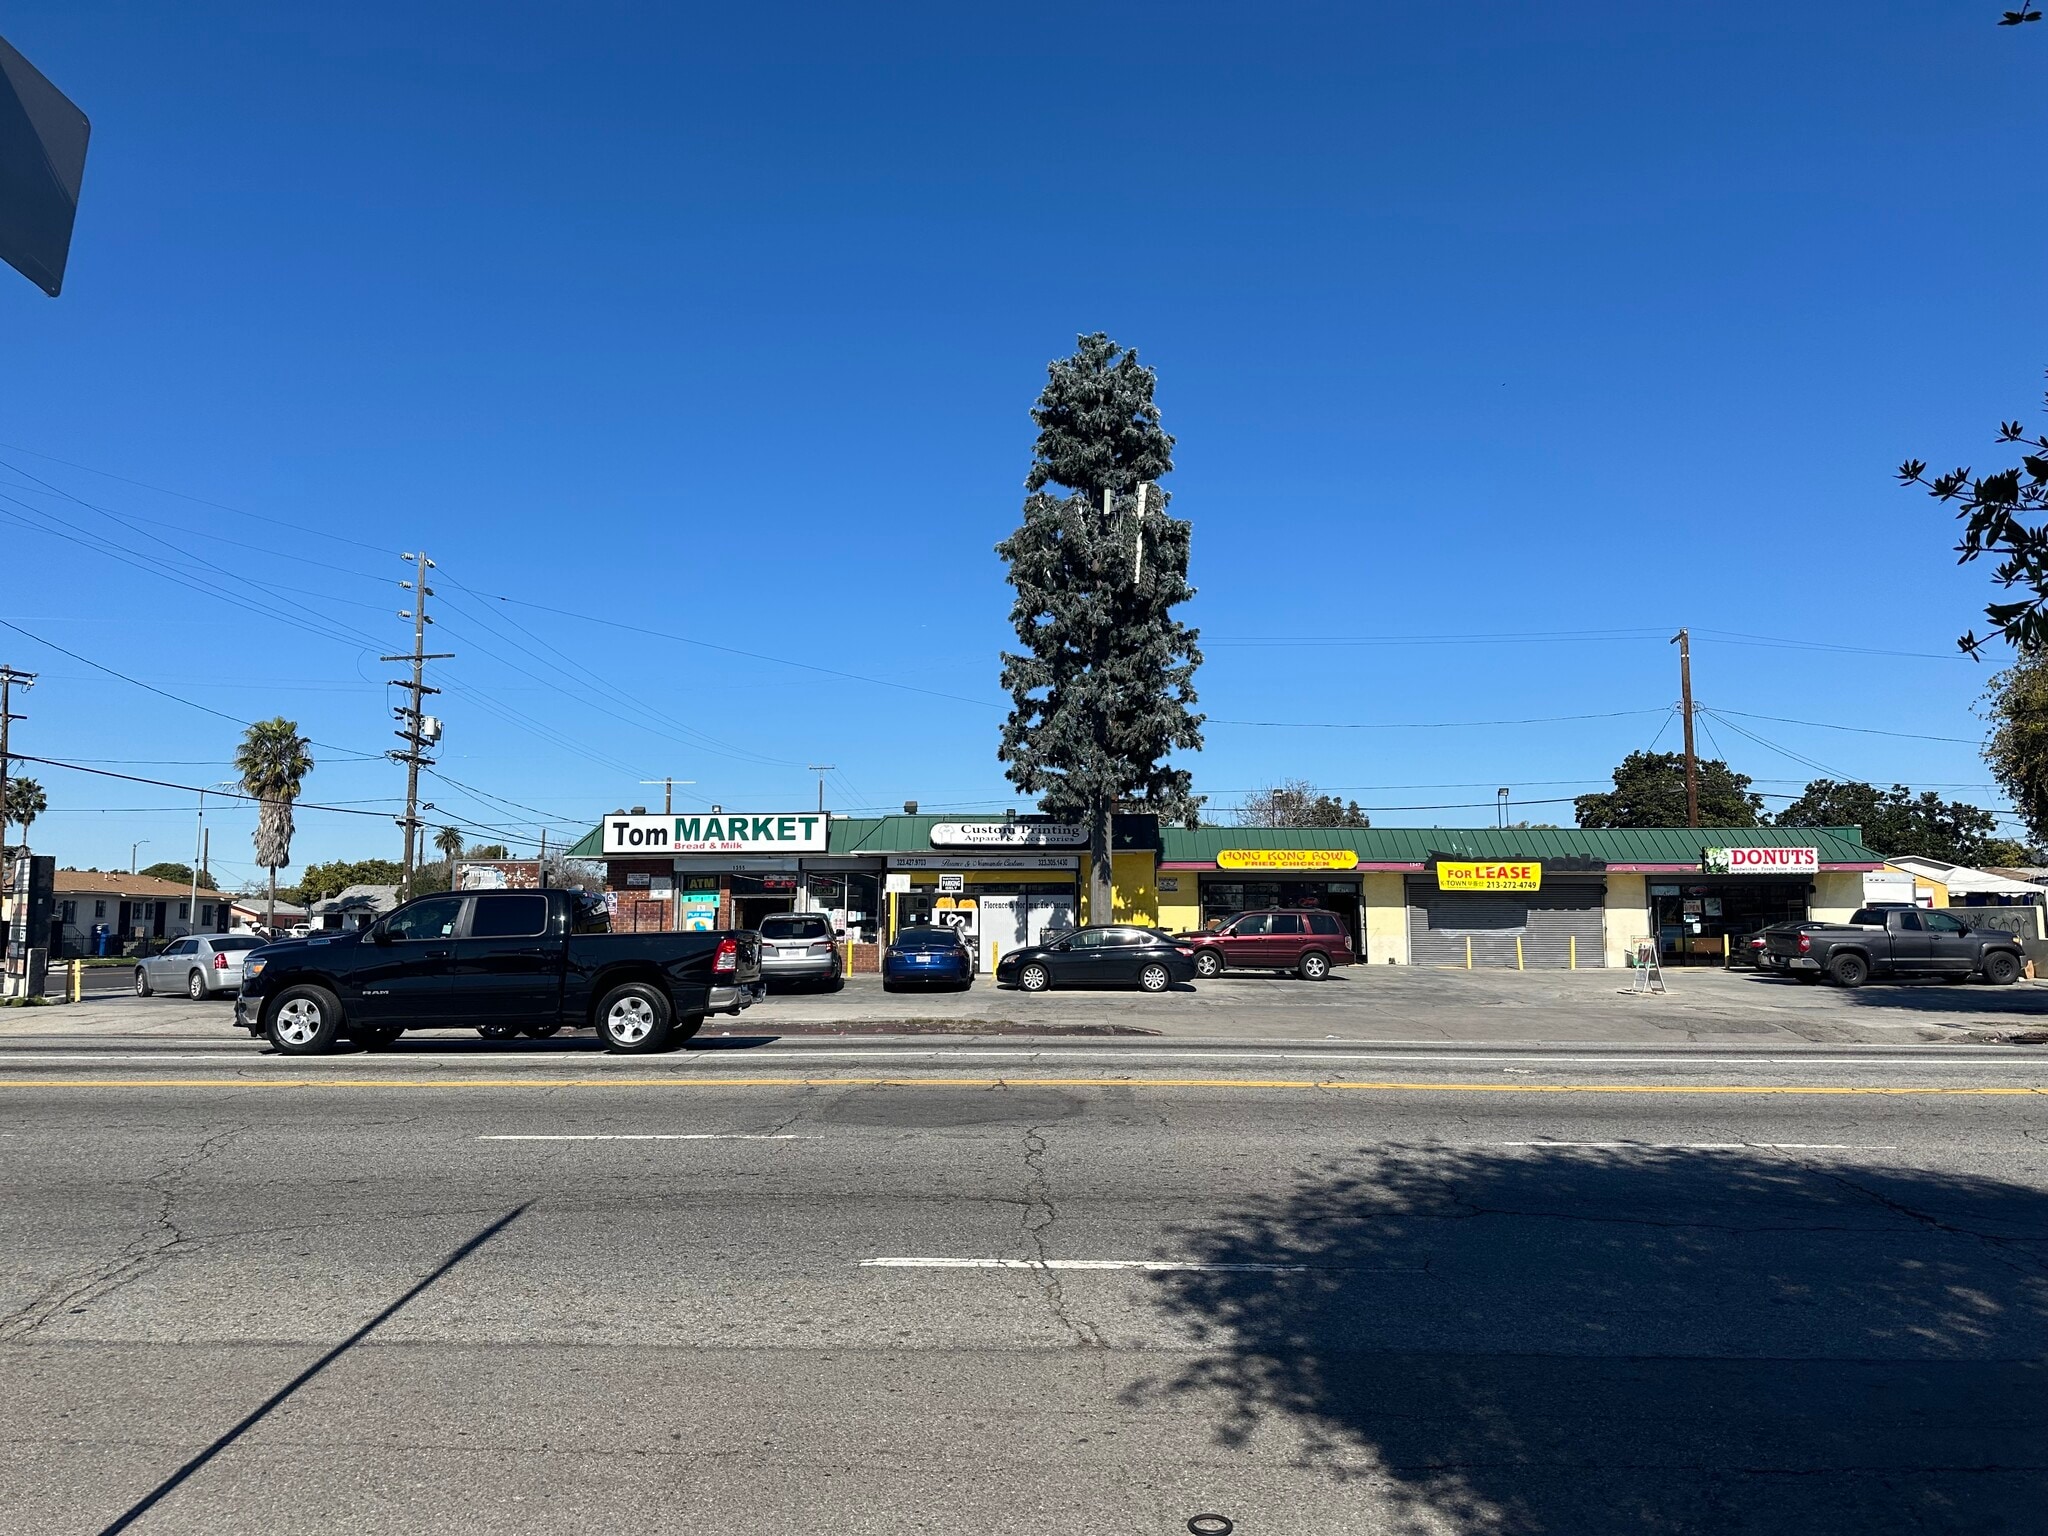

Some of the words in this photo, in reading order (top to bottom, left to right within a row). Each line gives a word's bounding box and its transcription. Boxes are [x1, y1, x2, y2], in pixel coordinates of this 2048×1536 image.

[613, 822, 668, 845] Tom
[674, 817, 819, 841] MARKET
[960, 824, 1016, 834] Custom
[1021, 824, 1080, 837] Printing
[964, 834, 1004, 843] Apparel
[674, 842, 705, 850] Bread
[1223, 851, 1261, 861] HONG
[1267, 851, 1306, 861] KONG
[1311, 851, 1352, 861] BOWL
[1731, 850, 1814, 865] DONUTS
[1447, 869, 1472, 879] FOR
[1475, 866, 1531, 879] LEASE
[690, 878, 714, 889] ATM
[942, 880, 961, 888] PARKING
[1486, 881, 1537, 889] 213-272-4749
[983, 900, 1008, 909] Florence
